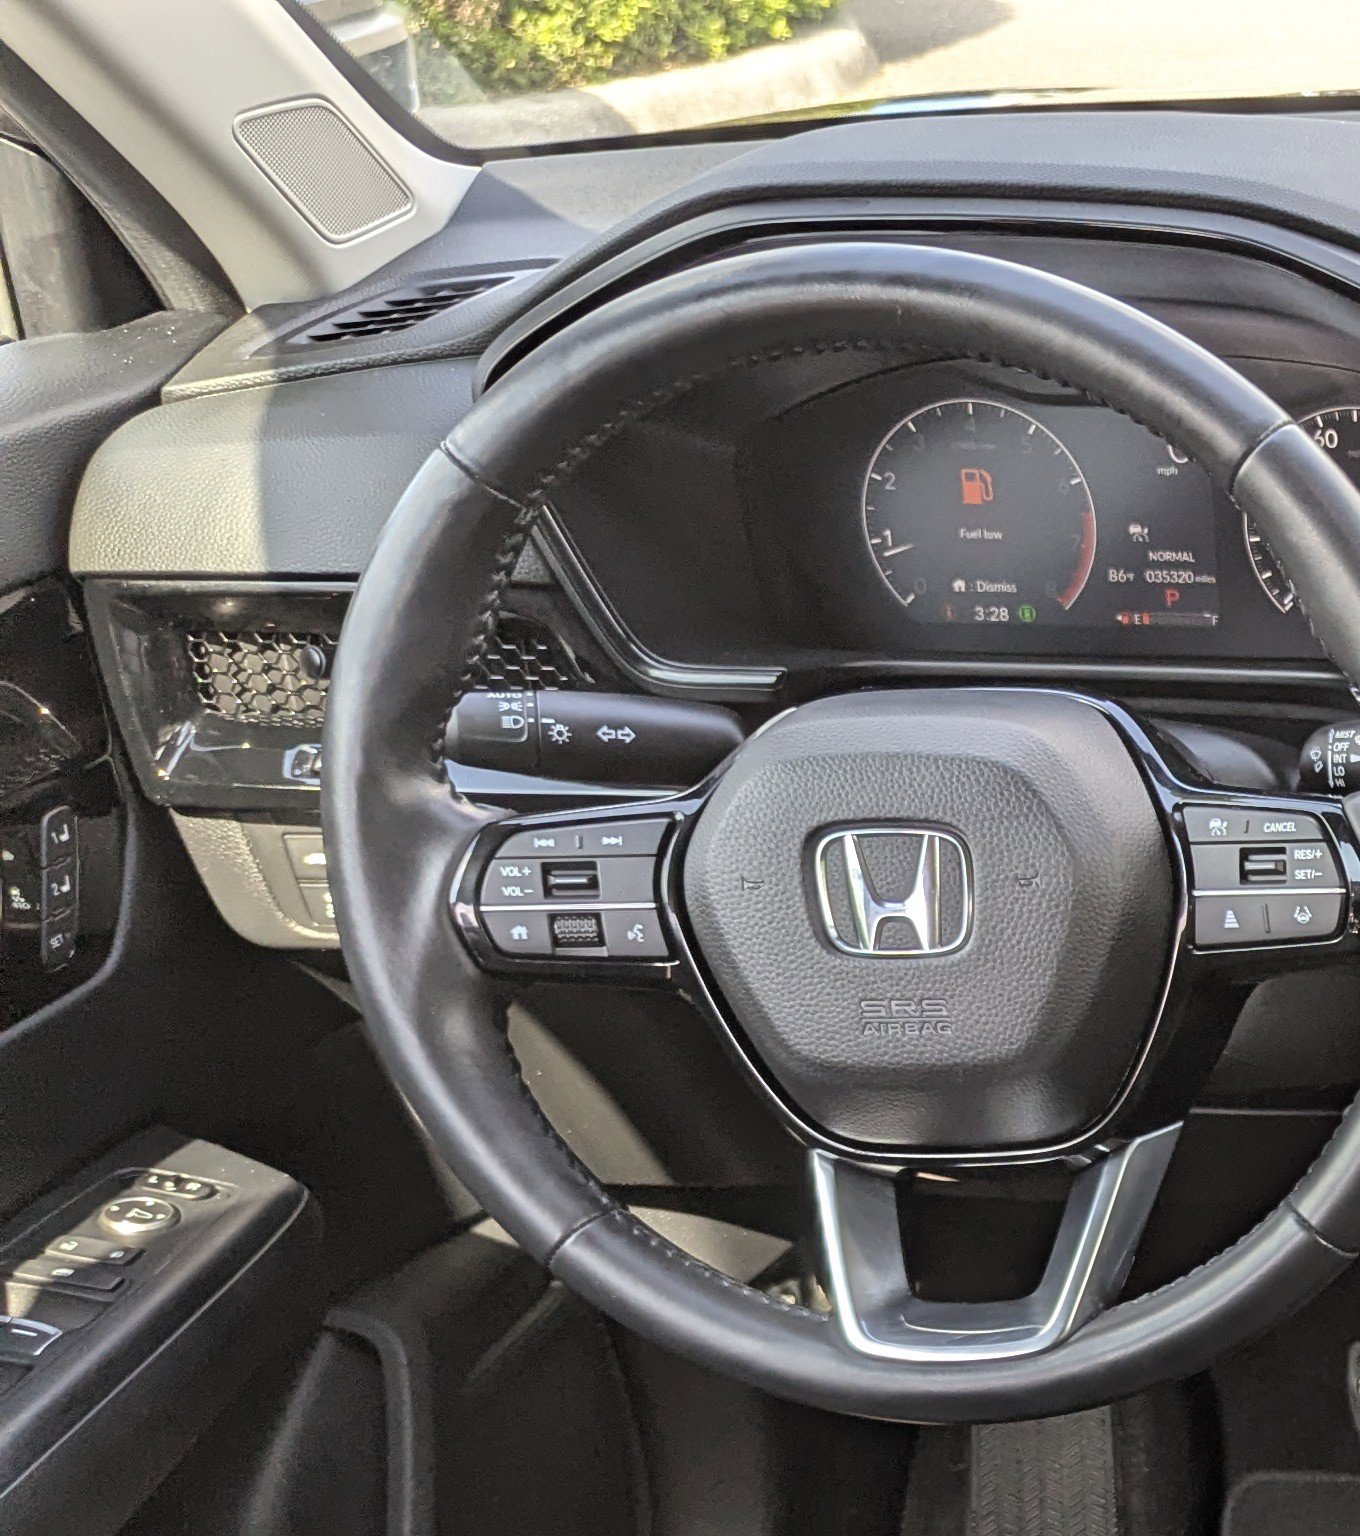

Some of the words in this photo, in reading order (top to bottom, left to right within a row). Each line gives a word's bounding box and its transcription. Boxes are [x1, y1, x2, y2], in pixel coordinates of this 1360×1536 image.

[883, 472, 896, 490] 2
[883, 529, 892, 546] 1
[959, 528, 981, 539] Fuel
[984, 529, 1003, 540] low
[1149, 551, 1195, 562] NORMAL
[1145, 570, 1194, 583] 035320
[976, 580, 1018, 593] Dismiss
[1165, 588, 1180, 607] P
[975, 606, 1010, 621] 3:28
[1134, 614, 1142, 624] E
[1212, 615, 1219, 625] F
[1333, 742, 1350, 752] OFF
[1333, 754, 1347, 763] INT
[1333, 766, 1345, 776] LO
[1263, 822, 1297, 833] CANCEL
[1294, 849, 1323, 860] RES/+
[500, 866, 532, 877] VOL+
[860, 999, 948, 1018] SRS
[862, 1022, 952, 1036] AIRBAG
